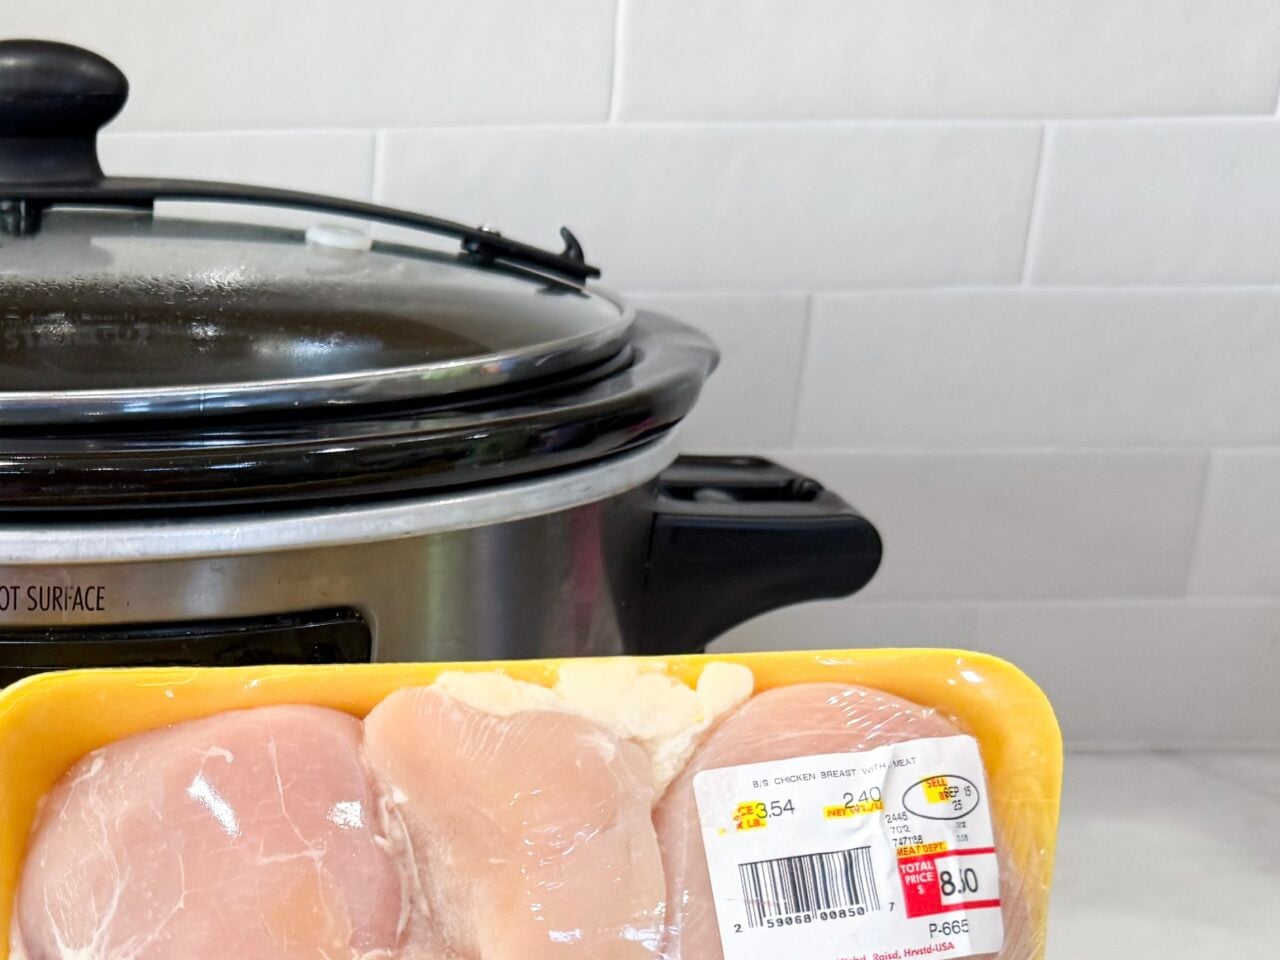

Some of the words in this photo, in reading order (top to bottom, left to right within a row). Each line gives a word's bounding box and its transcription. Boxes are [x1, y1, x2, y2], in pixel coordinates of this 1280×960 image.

[27, 586, 106, 611] SURFACE
[774, 773, 816, 785] CHICKEN
[820, 769, 857, 779] BREAST
[755, 799, 796, 819] 3.54
[897, 845, 921, 856] MEAT
[901, 861, 934, 874] TOTAL
[904, 872, 933, 885] PRICE
[767, 914, 812, 929] 59068
[820, 907, 866, 922] 00850
